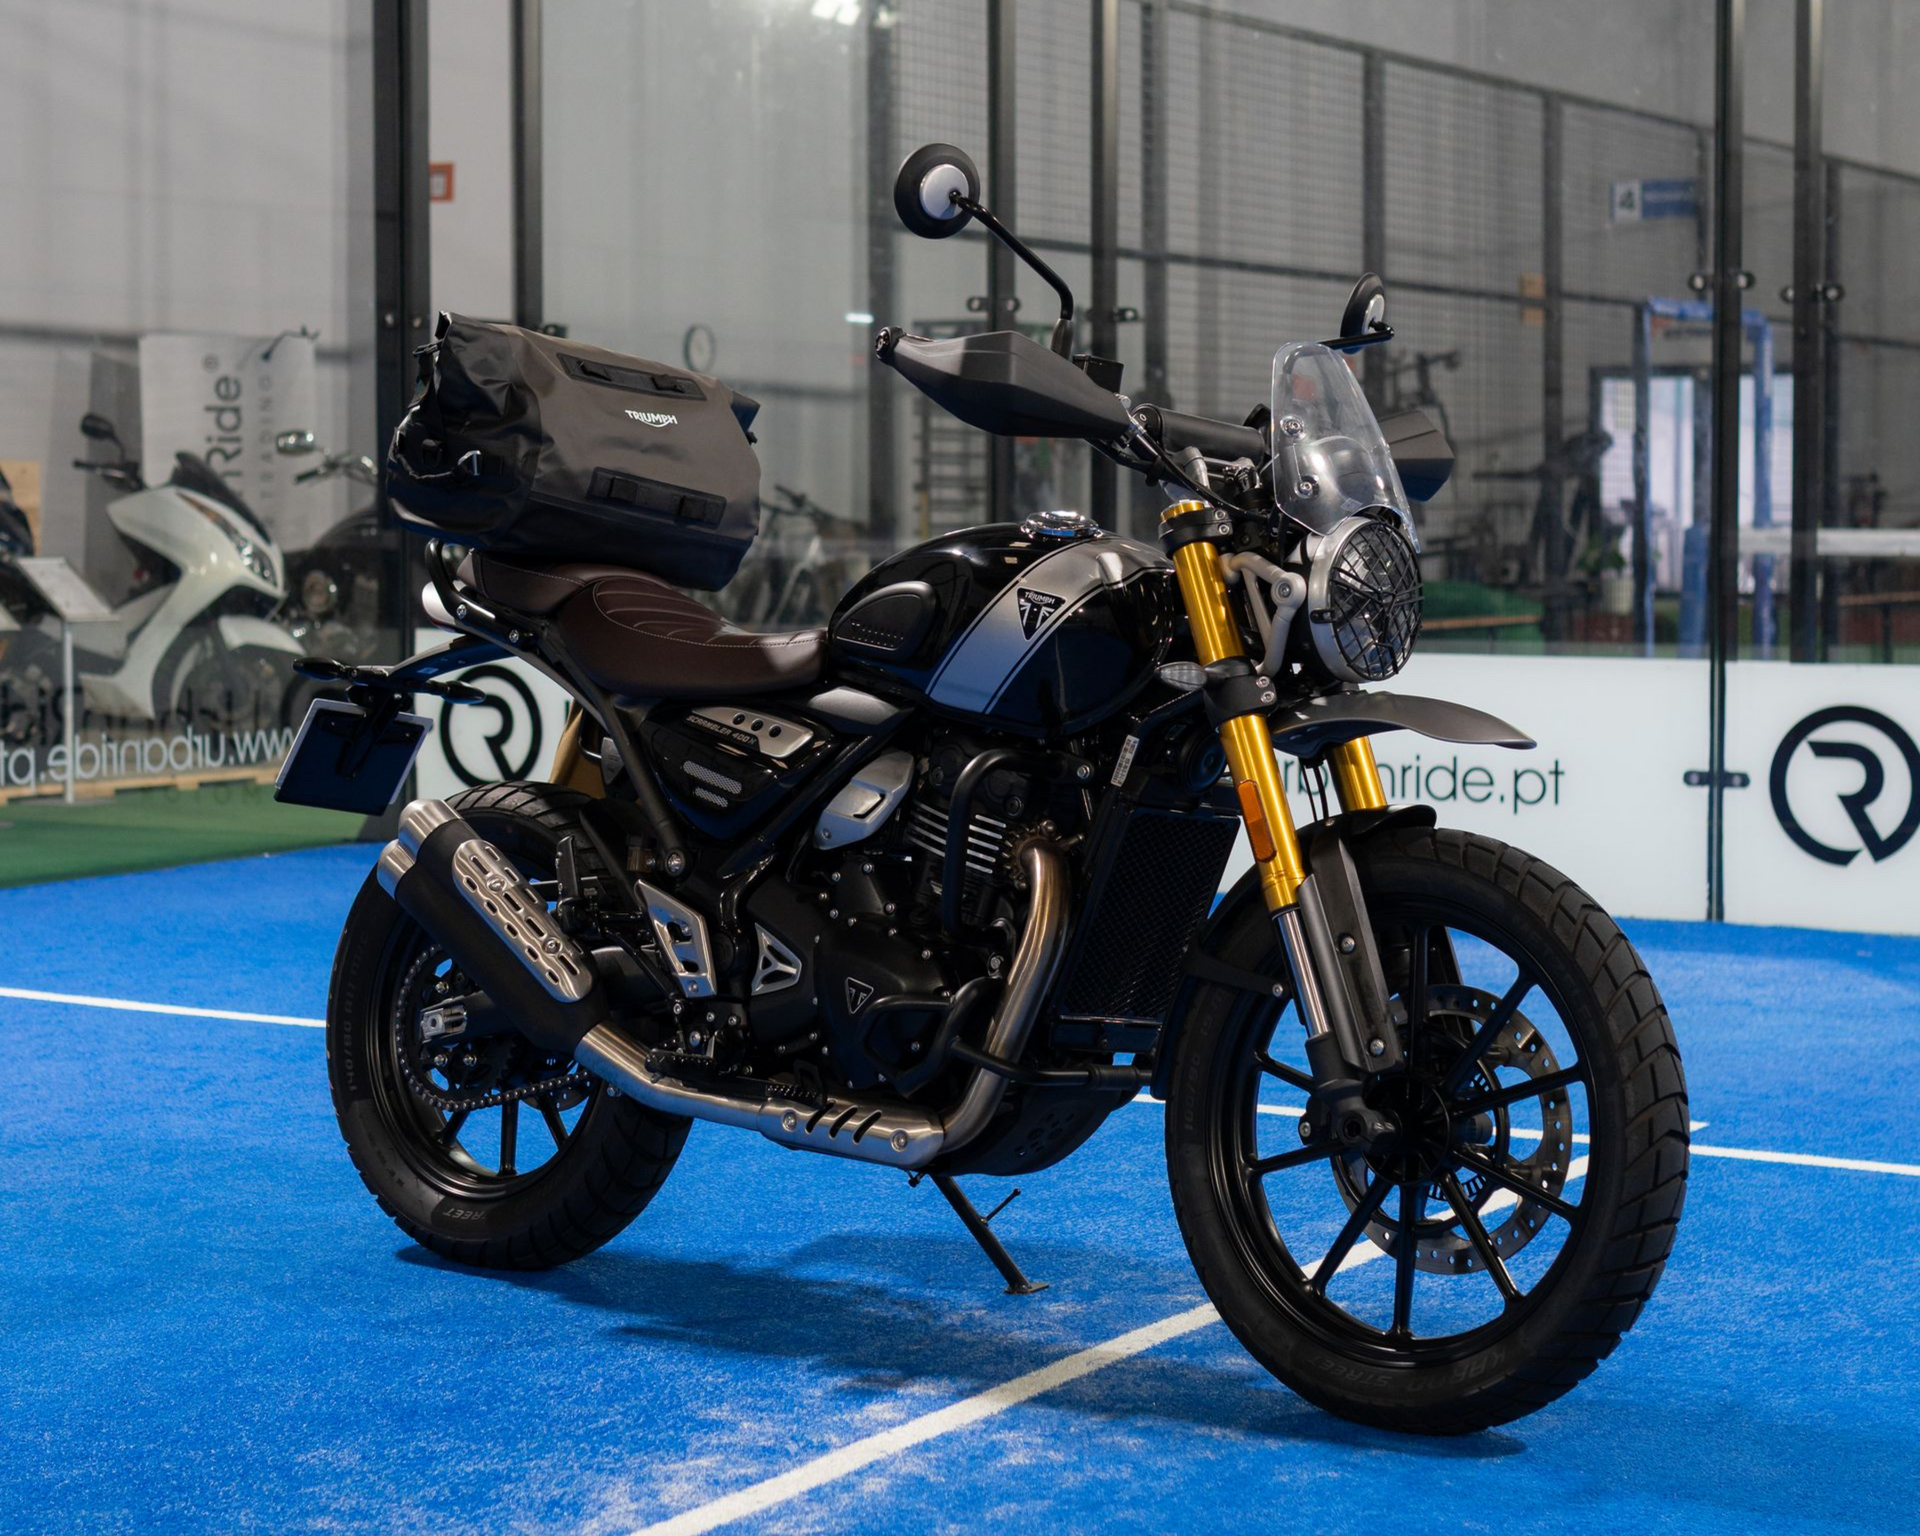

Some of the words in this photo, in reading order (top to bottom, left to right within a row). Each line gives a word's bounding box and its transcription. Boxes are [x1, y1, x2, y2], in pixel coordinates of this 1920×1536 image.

[624, 409, 678, 427] TRIUMPH
[257, 375, 273, 500] TRADING
[1024, 591, 1056, 605] TRIUMPH
[685, 714, 732, 736] SCRAMBLER
[1280, 756, 1565, 814] rbnride.pt
[441, 1207, 487, 1222] REET
[1306, 1354, 1393, 1388] STREET
